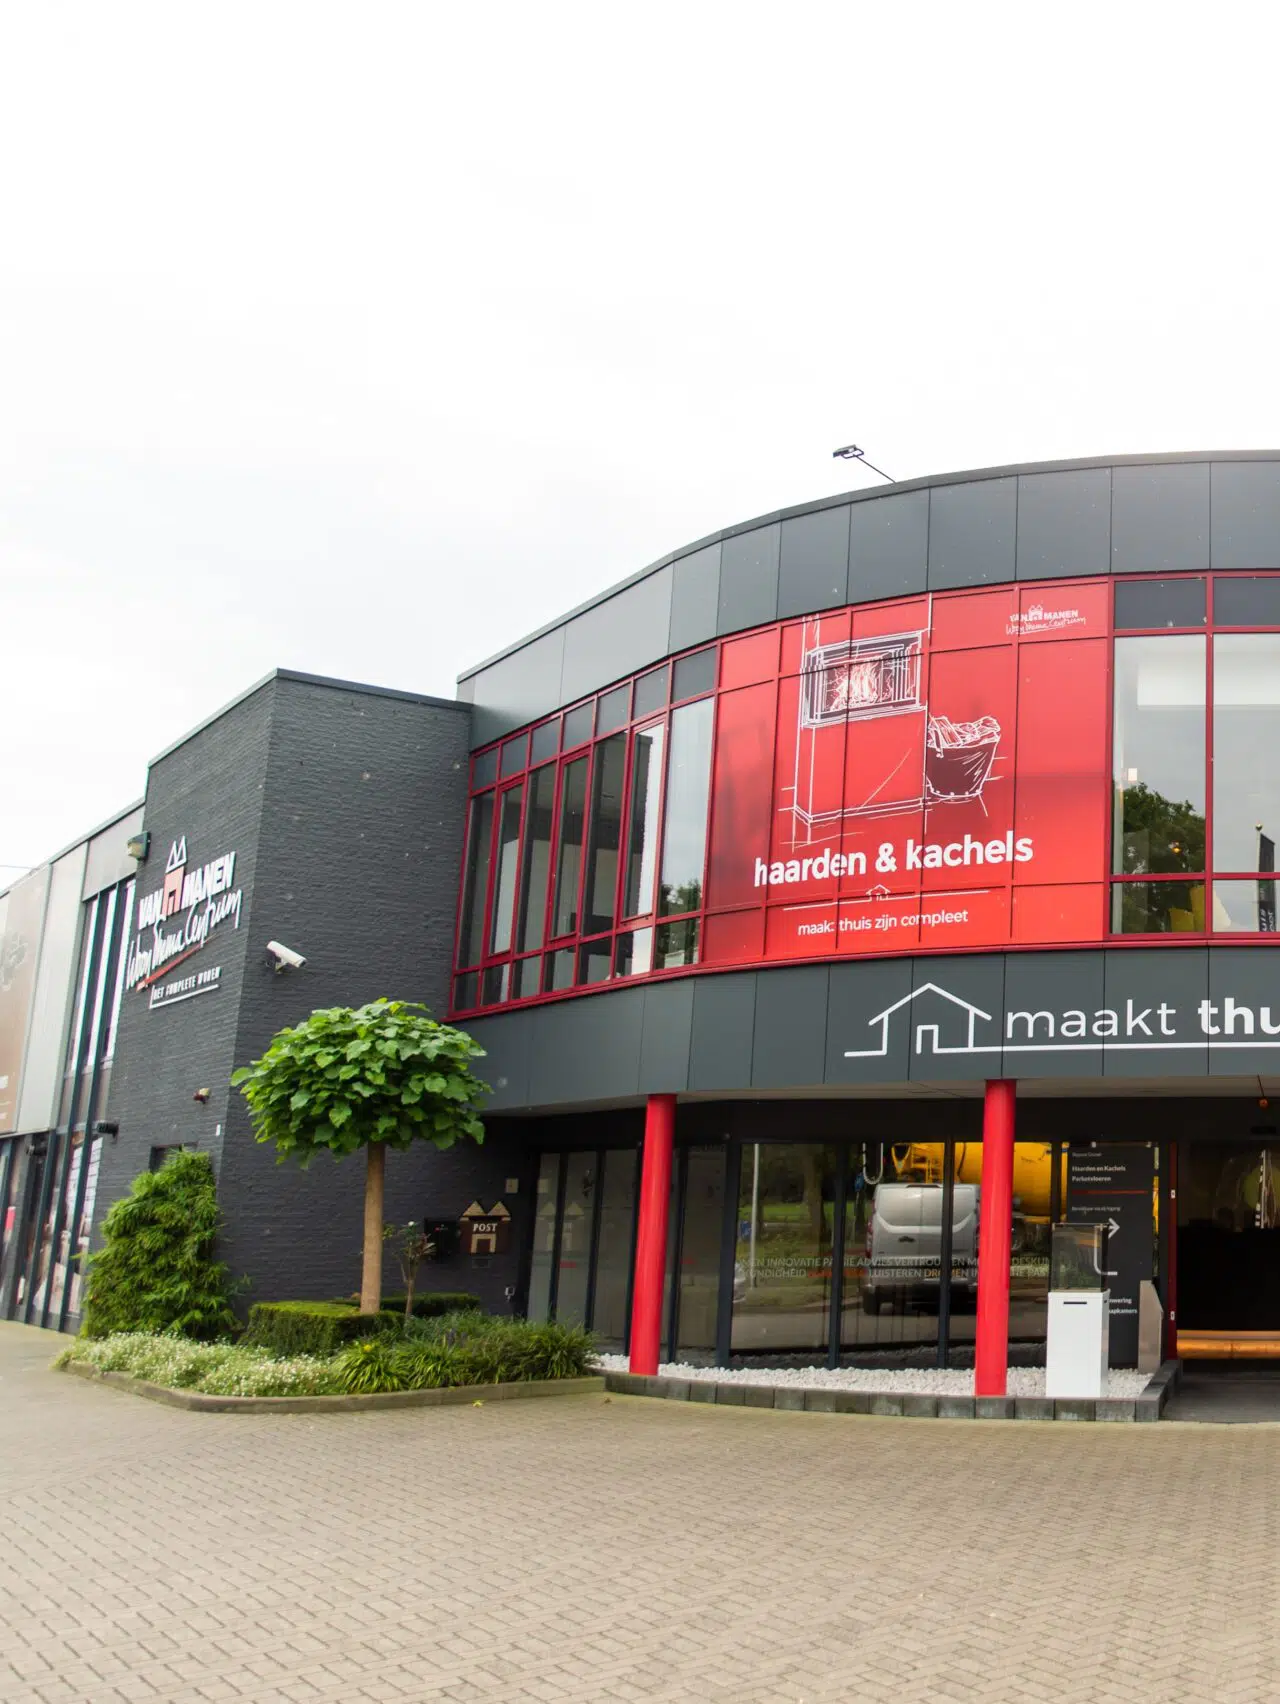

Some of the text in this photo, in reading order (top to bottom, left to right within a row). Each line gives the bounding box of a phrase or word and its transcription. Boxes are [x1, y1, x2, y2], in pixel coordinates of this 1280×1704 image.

[1044, 609, 1079, 620] MANEN
[754, 830, 1034, 887] haarden & kachels
[139, 851, 237, 930] VAN MANEN
[839, 916, 872, 932] thuis
[875, 915, 898, 932] zijn
[901, 910, 969, 927] compleet
[166, 975, 197, 997] COMPLETE
[1006, 999, 1177, 1038] maakt
[473, 1223, 498, 1232] POST
[766, 1258, 821, 1267] INNOVATIE
[895, 1257, 965, 1266] VERTROUEN
